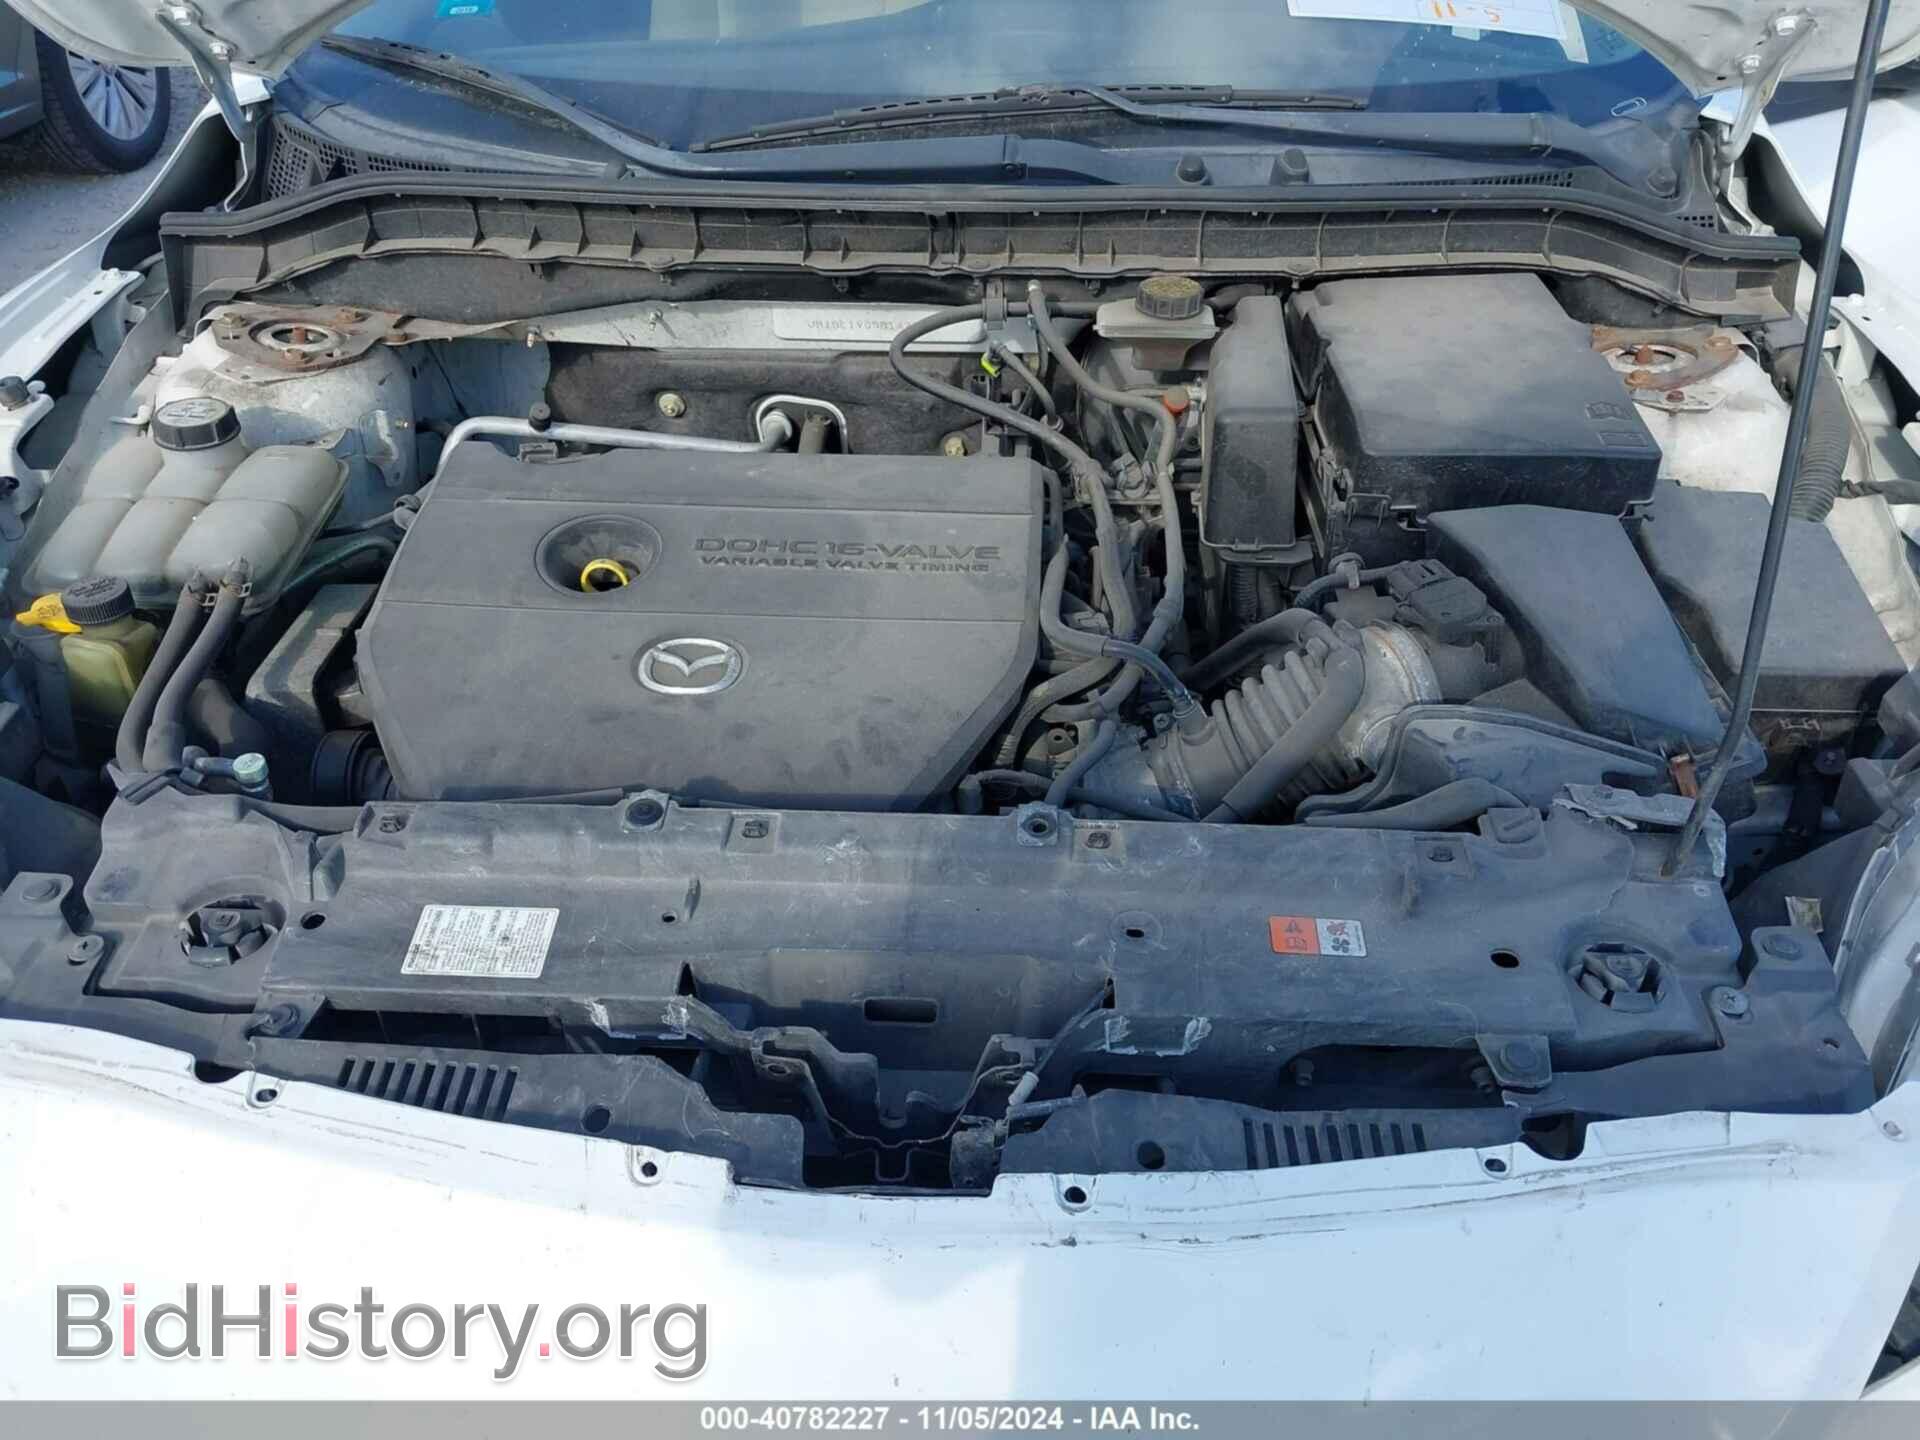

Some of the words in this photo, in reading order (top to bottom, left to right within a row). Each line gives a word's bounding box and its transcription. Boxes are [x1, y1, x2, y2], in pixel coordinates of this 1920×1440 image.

[696, 538, 817, 554] DOHC
[826, 541, 1001, 559] 16-VALVE
[701, 556, 818, 568] VARIABLE
[826, 558, 899, 571] VALVE
[909, 561, 990, 573] TIMING
